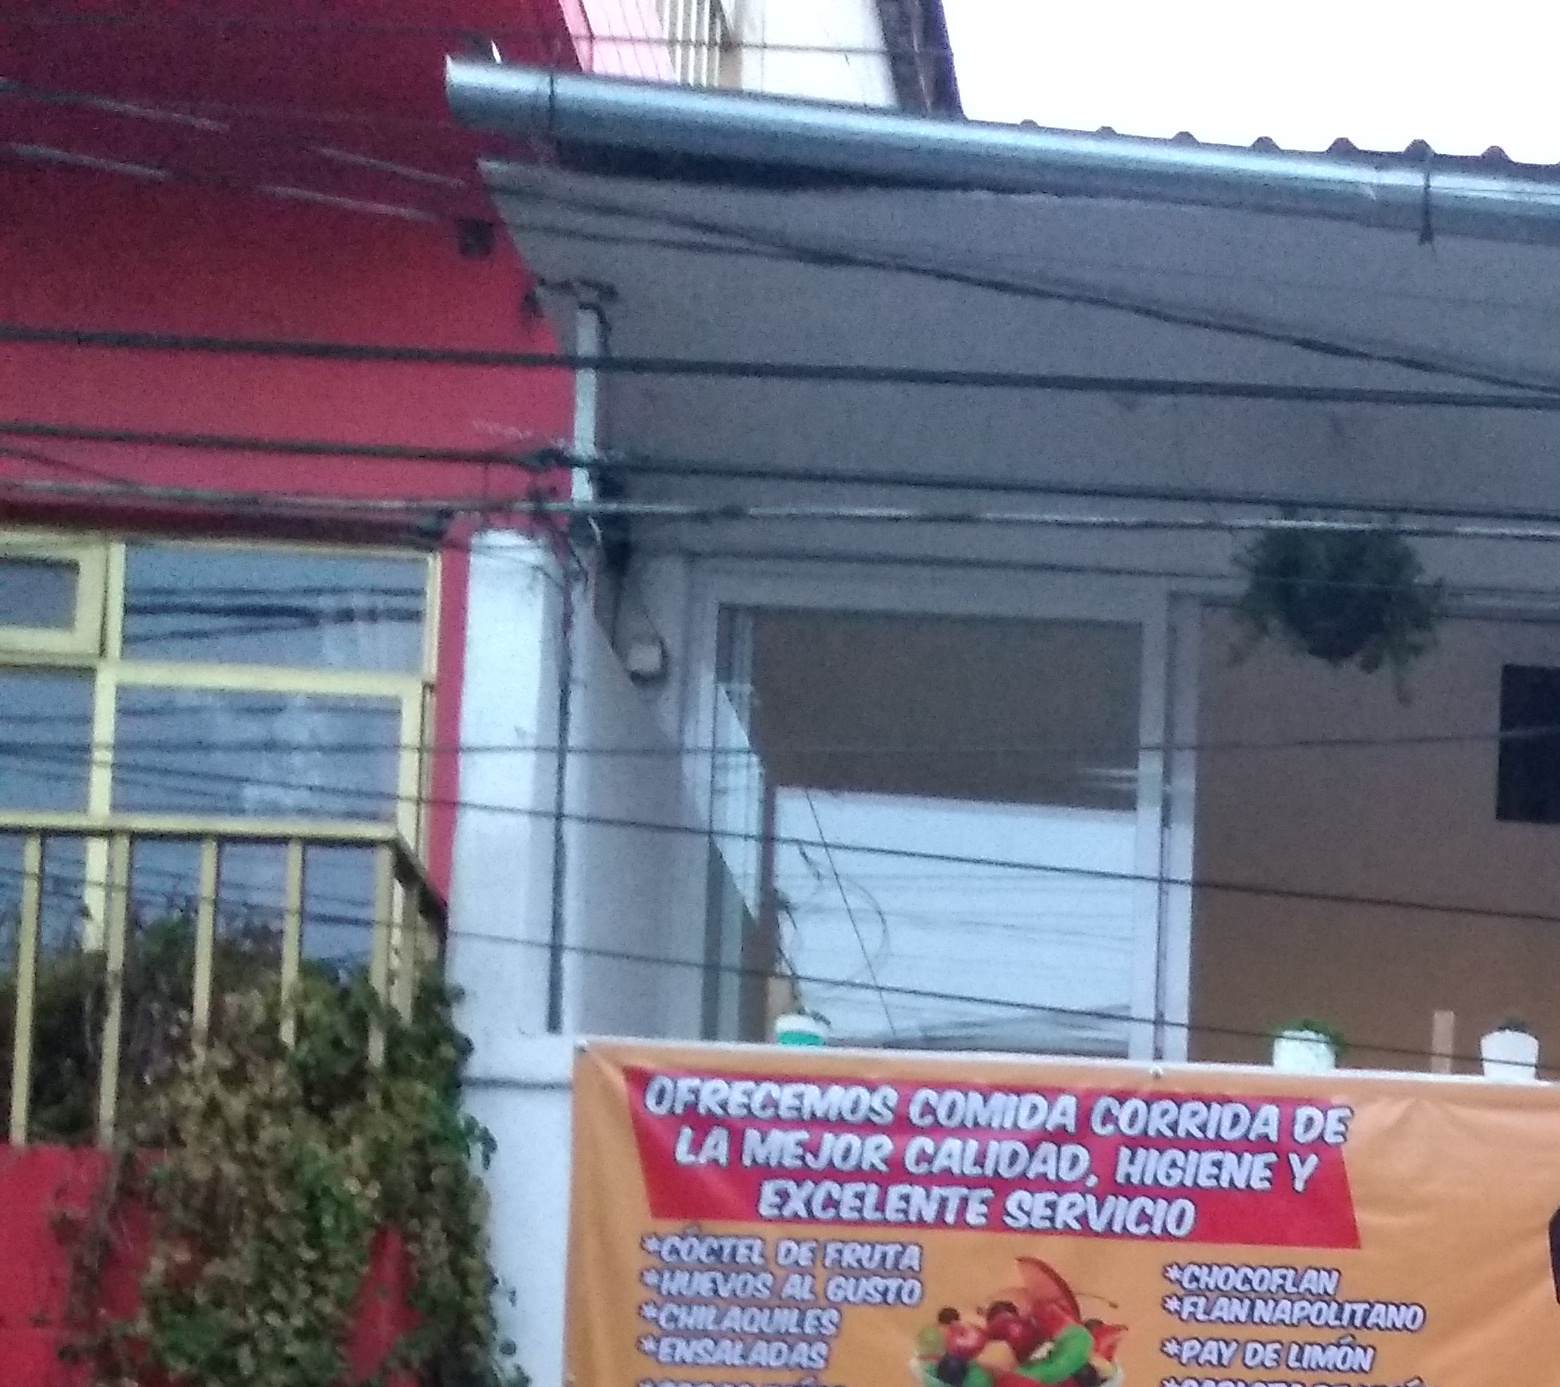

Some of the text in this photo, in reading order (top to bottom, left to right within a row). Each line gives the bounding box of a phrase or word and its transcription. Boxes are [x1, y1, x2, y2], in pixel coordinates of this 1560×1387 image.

[644, 1074, 1353, 1145] OFRECEMOS COMIDA CORRIDA DE
[675, 1125, 1320, 1193] LA MEJOR CALIDAD, HIGIENE Y
[757, 1179, 1196, 1237] EXCELENTE SERVICIO
[776, 1239, 818, 1268] DE
[823, 1240, 922, 1272] FRUTA
[780, 1273, 816, 1301] AL
[825, 1275, 924, 1306] GUSTO
[1253, 1297, 1426, 1333] NAPOLITANO
[1243, 1340, 1283, 1369] DE
[1287, 1334, 1376, 1373] LIMÓN
